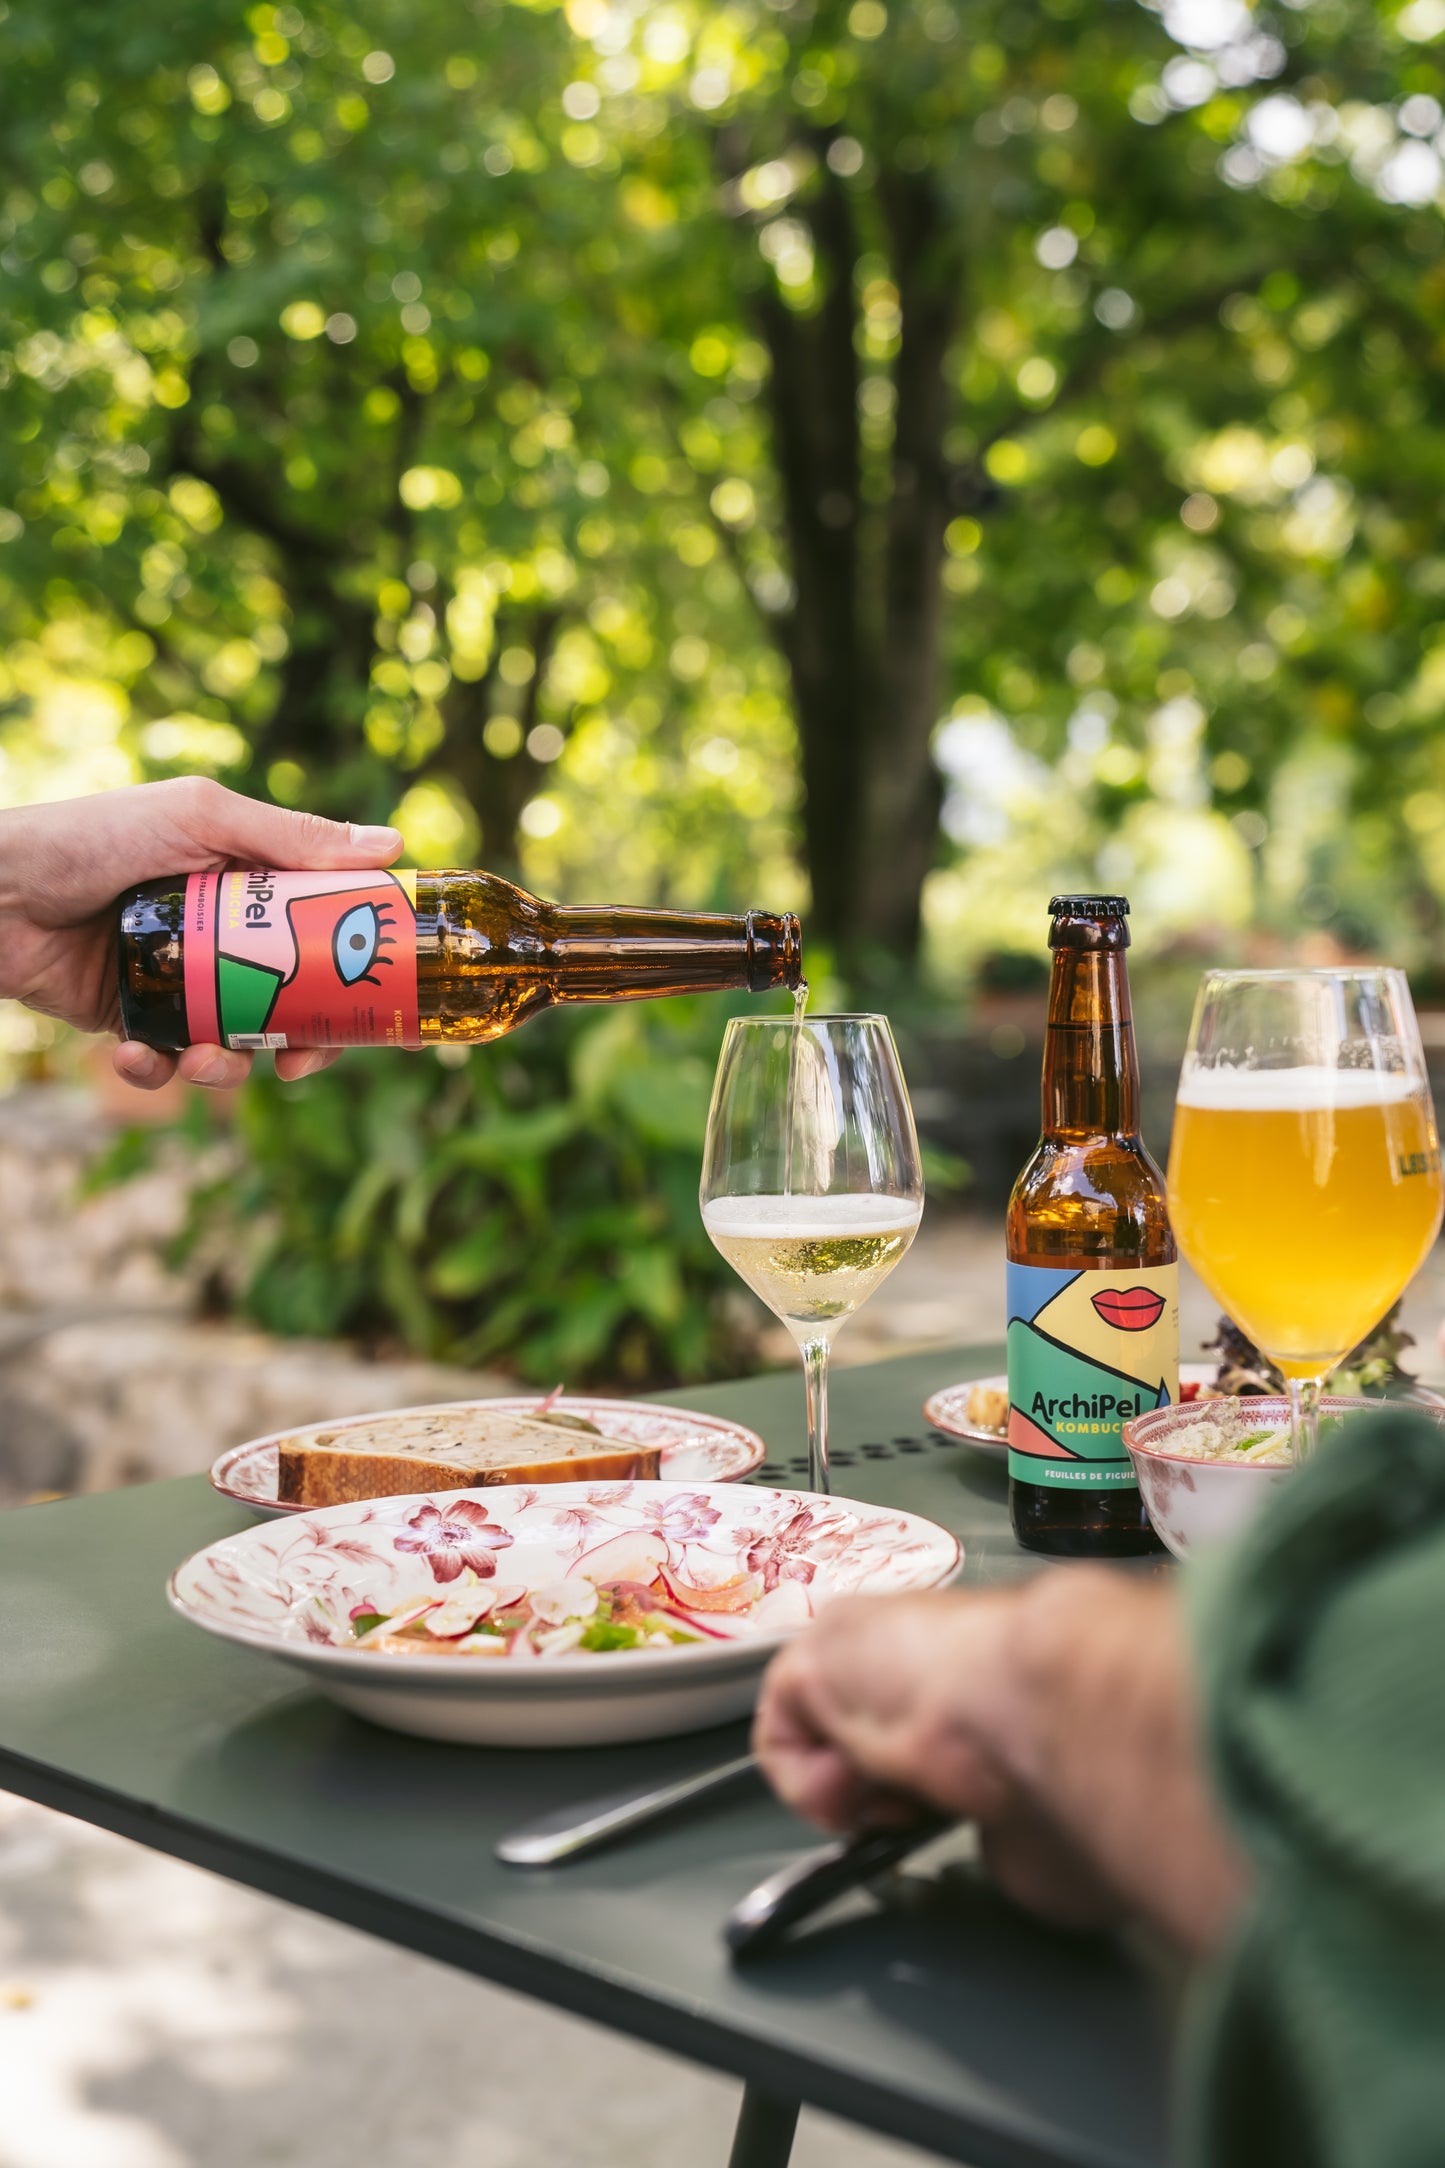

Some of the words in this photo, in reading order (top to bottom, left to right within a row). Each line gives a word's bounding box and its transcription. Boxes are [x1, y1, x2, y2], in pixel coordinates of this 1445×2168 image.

[197, 881, 207, 931] FRAMBOISIER
[246, 871, 276, 928] chiPel
[1032, 1391, 1140, 1424] ArchiPel
[1045, 1470, 1086, 1480] FEUILLES
[1106, 1472, 1136, 1480] FIGUIE
